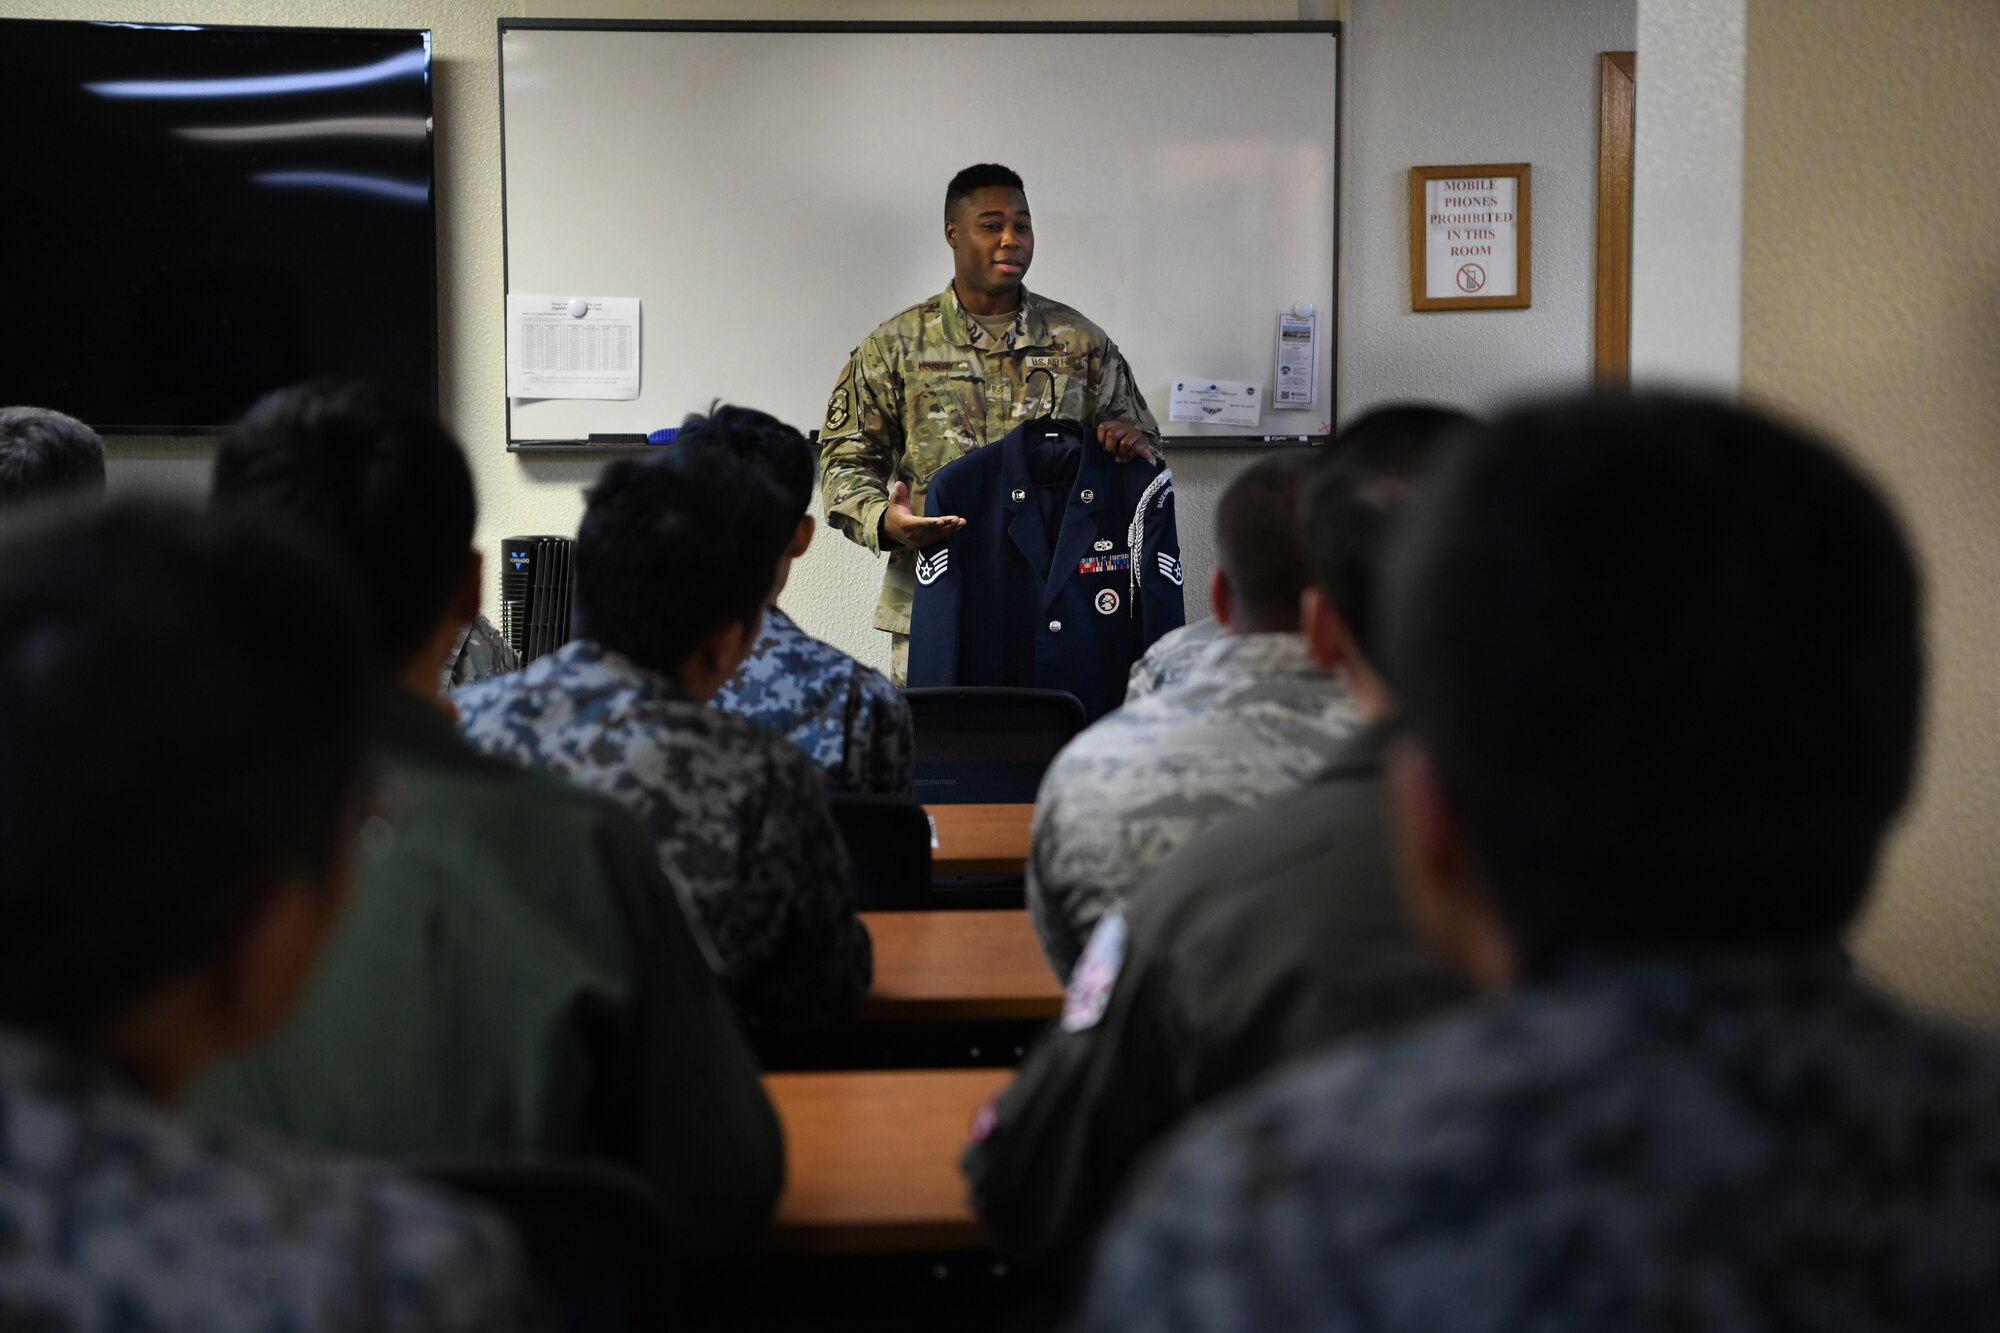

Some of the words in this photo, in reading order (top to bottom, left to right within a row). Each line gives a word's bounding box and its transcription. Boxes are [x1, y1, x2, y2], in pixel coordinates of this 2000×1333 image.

[1444, 180, 1497, 191] MOBILE
[1444, 196, 1498, 207] PHONES
[1430, 212, 1513, 224] PROHIBITED
[1447, 230, 1461, 240] IN
[1464, 229, 1495, 239] THIS
[1450, 245, 1492, 256] ROOM
[1031, 357, 1046, 367] U.S.
[1047, 358, 1059, 367] AIR
